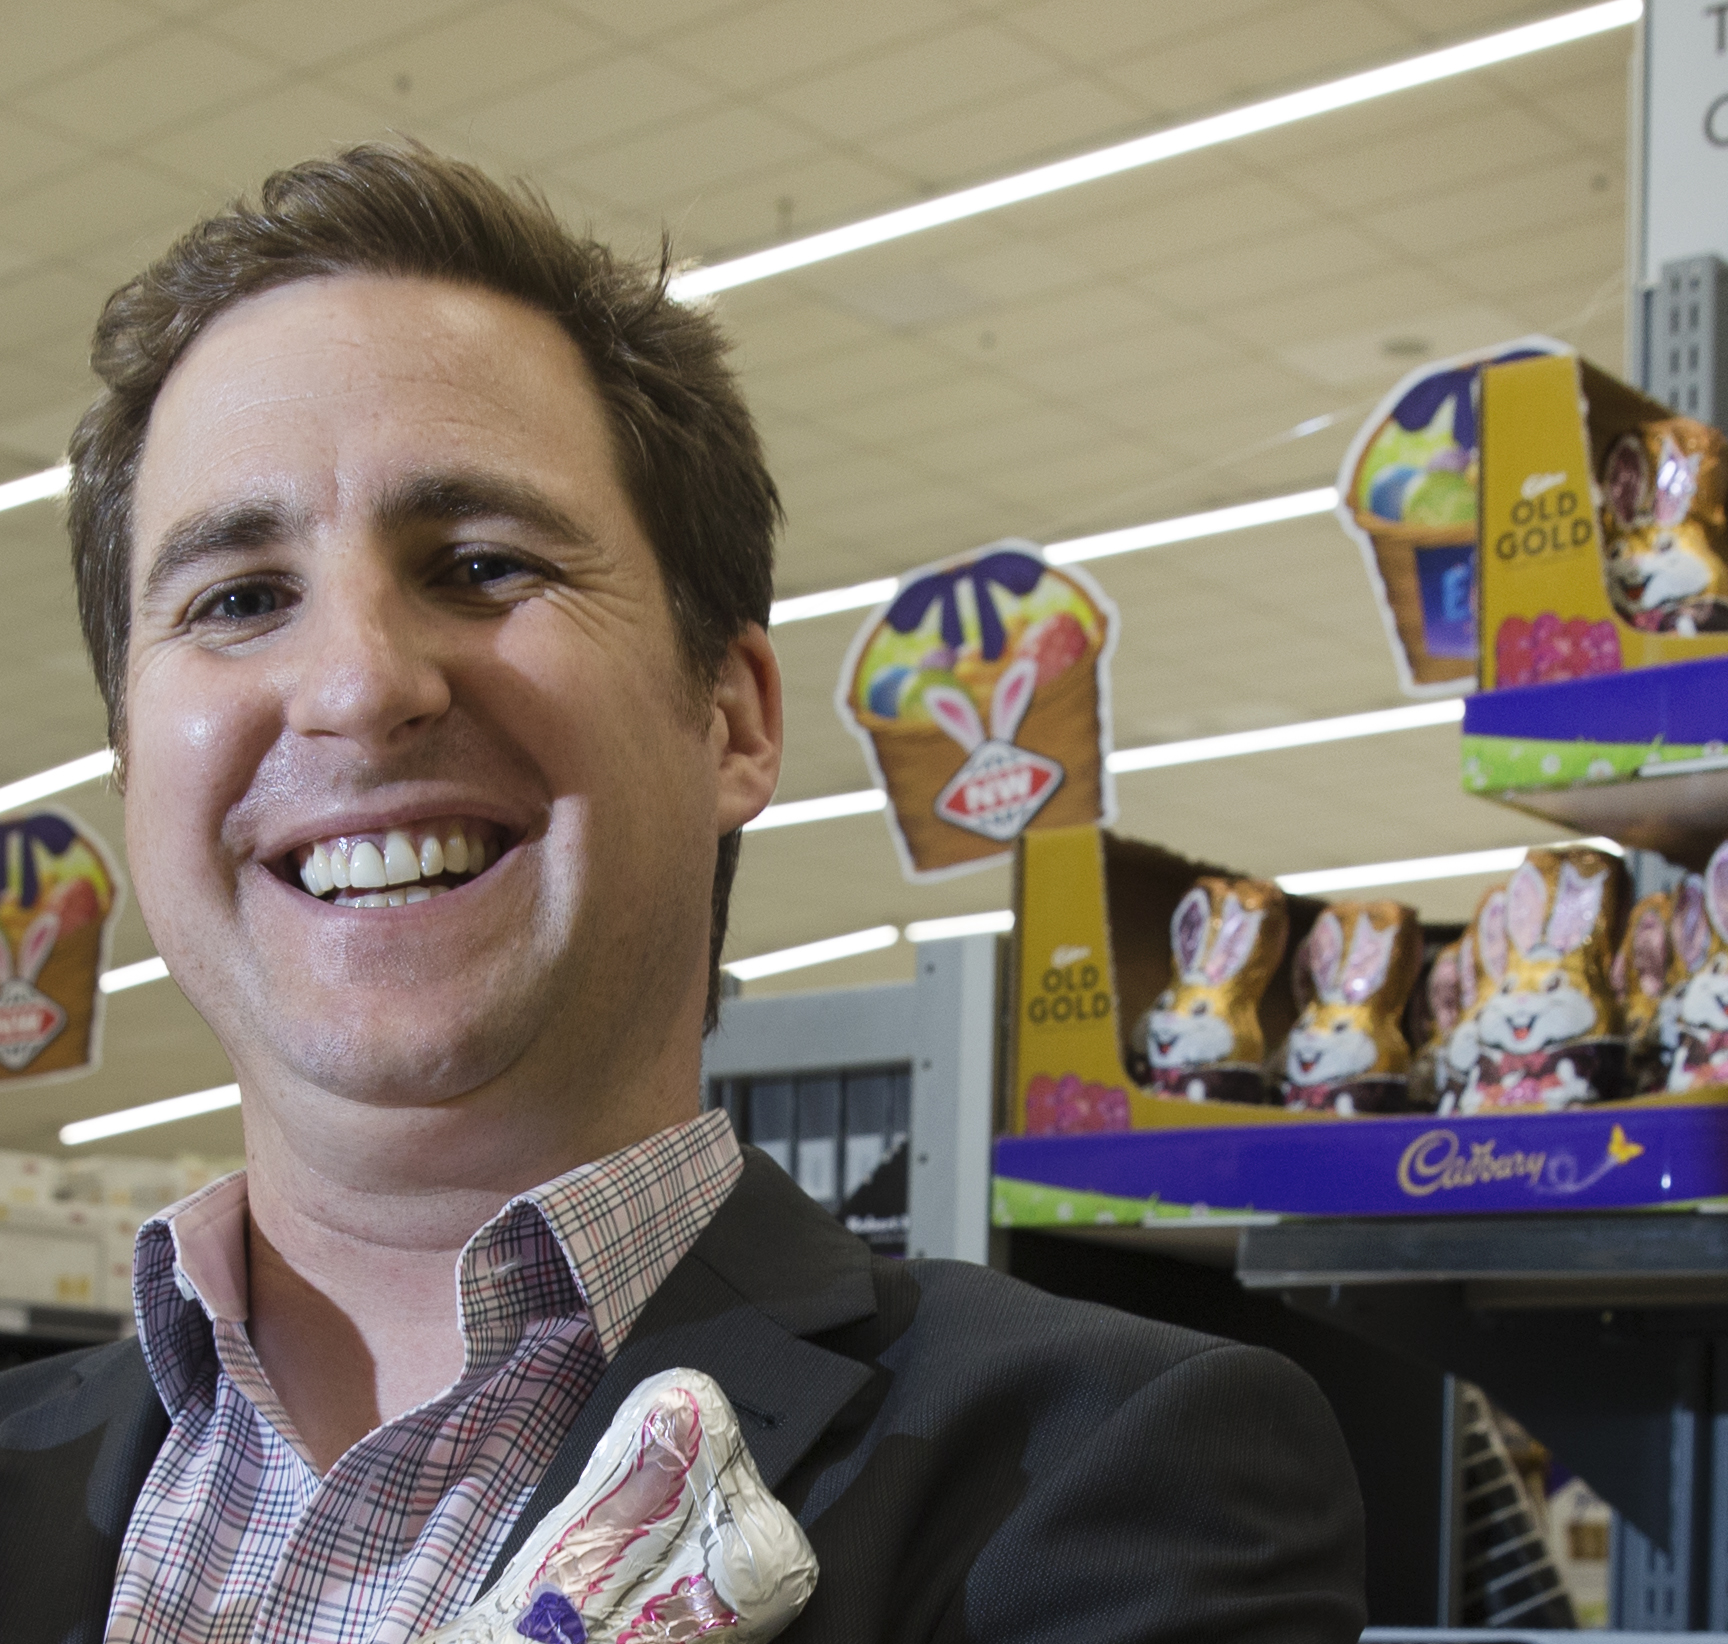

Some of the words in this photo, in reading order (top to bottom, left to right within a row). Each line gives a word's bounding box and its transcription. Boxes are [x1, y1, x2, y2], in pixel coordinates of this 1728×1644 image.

[1509, 490, 1578, 527] OLD
[1495, 520, 1593, 561] GOLD
[965, 766, 1031, 814] NW
[1041, 965, 1100, 994] OLD
[1028, 992, 1112, 1025] GOLD
[1398, 1129, 1547, 1196] Cadbury
